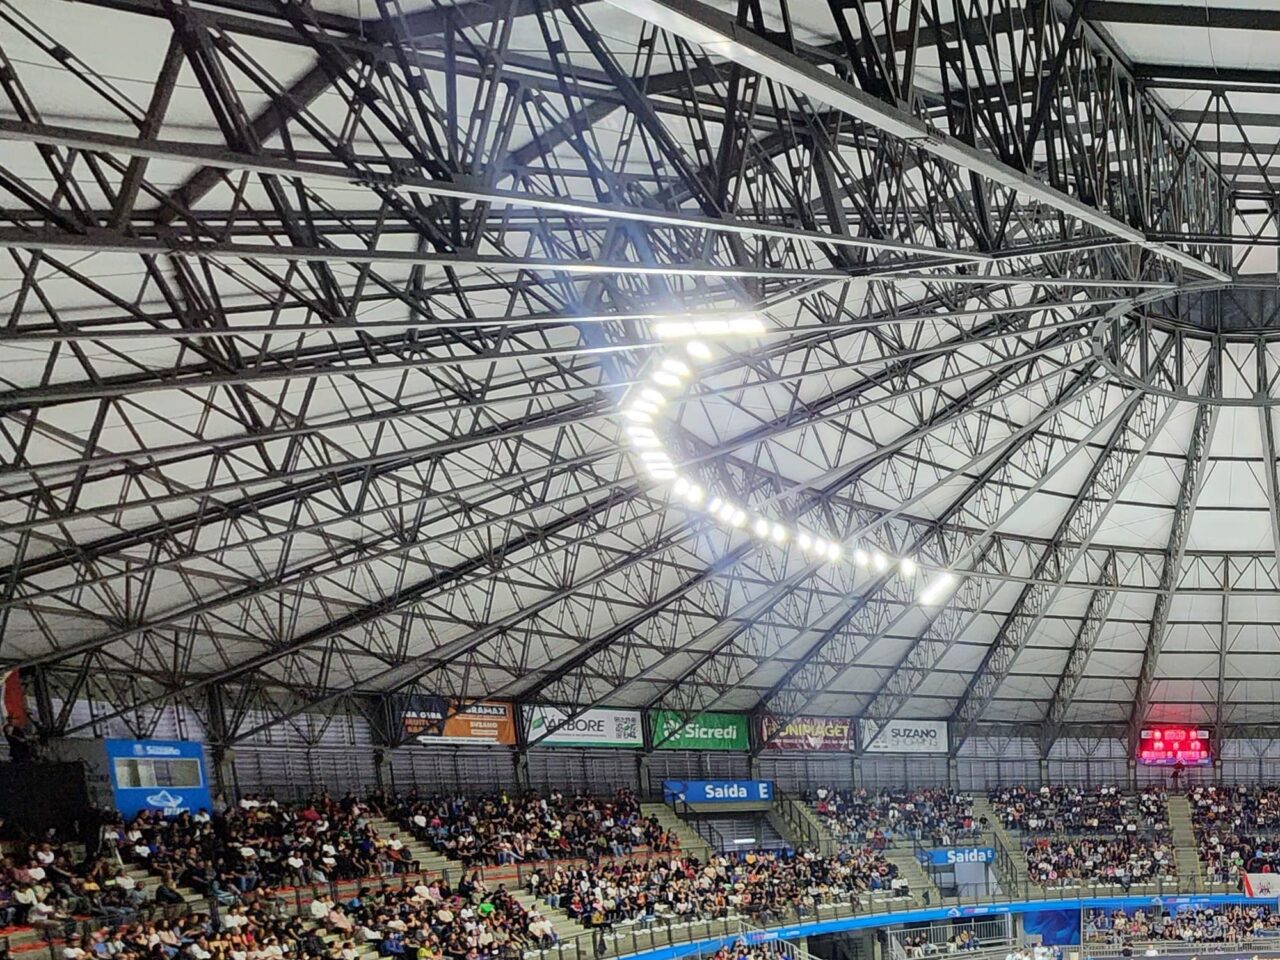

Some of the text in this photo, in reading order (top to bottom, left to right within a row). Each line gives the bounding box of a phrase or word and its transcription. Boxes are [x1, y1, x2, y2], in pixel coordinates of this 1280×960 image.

[685, 723, 737, 739] Sicredi
[891, 728, 937, 738] SUZANO
[704, 783, 769, 799] Saída E
[947, 848, 993, 863] Saída E
